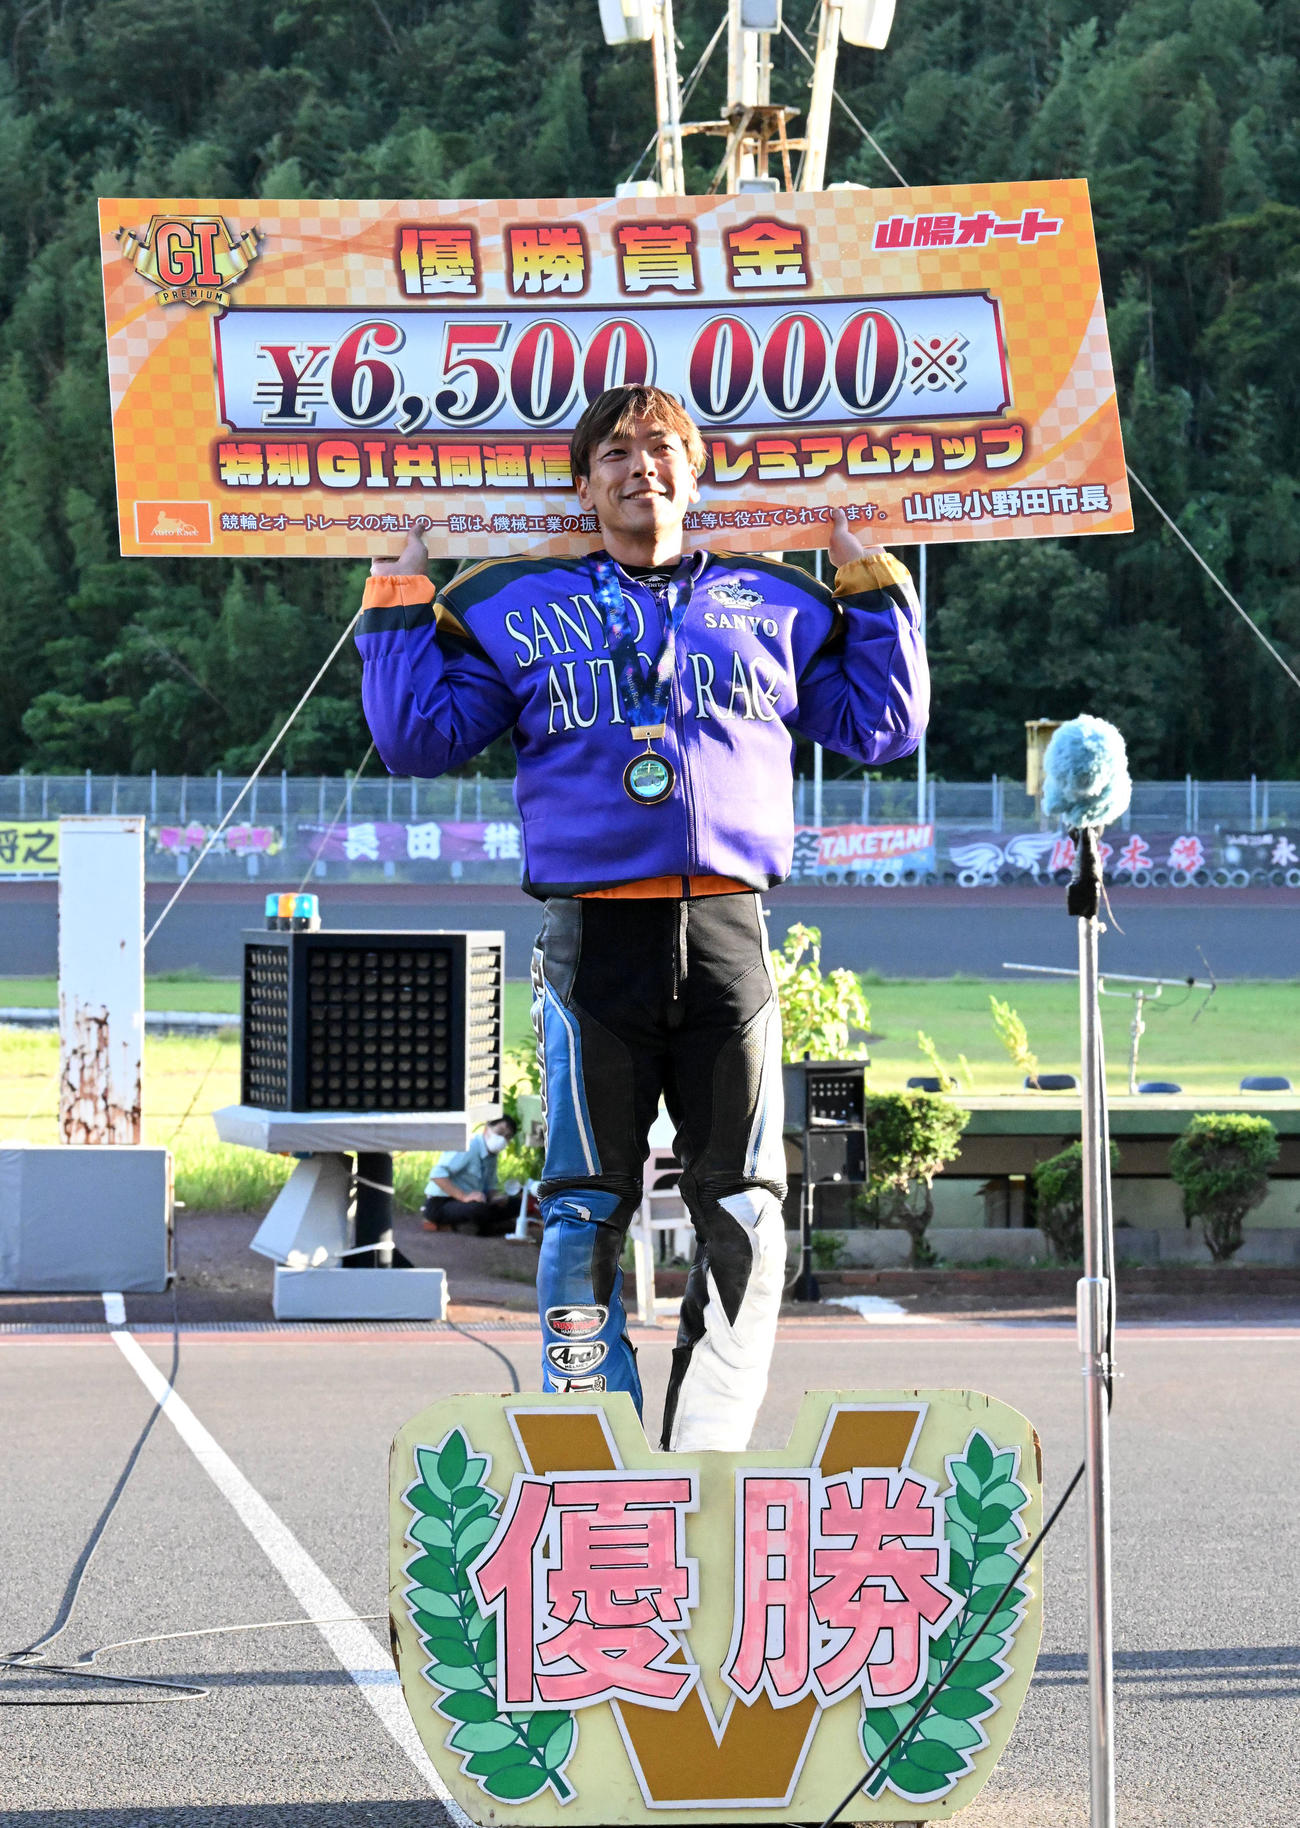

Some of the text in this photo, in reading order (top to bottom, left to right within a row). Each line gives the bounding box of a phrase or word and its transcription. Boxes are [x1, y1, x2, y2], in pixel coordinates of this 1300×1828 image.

[874, 210, 1060, 249] 山陽オート
[156, 223, 223, 286] GI
[399, 219, 809, 296] 優勝賞金
[162, 288, 224, 301] PREMIUM
[904, 485, 1110, 522] 山陽小野田市長
[704, 612, 779, 638] SANYO
[547, 651, 653, 734] AUT
[820, 826, 931, 859] TAKETANI
[552, 1346, 600, 1365] Arai
[474, 1474, 956, 1707] 優勝
